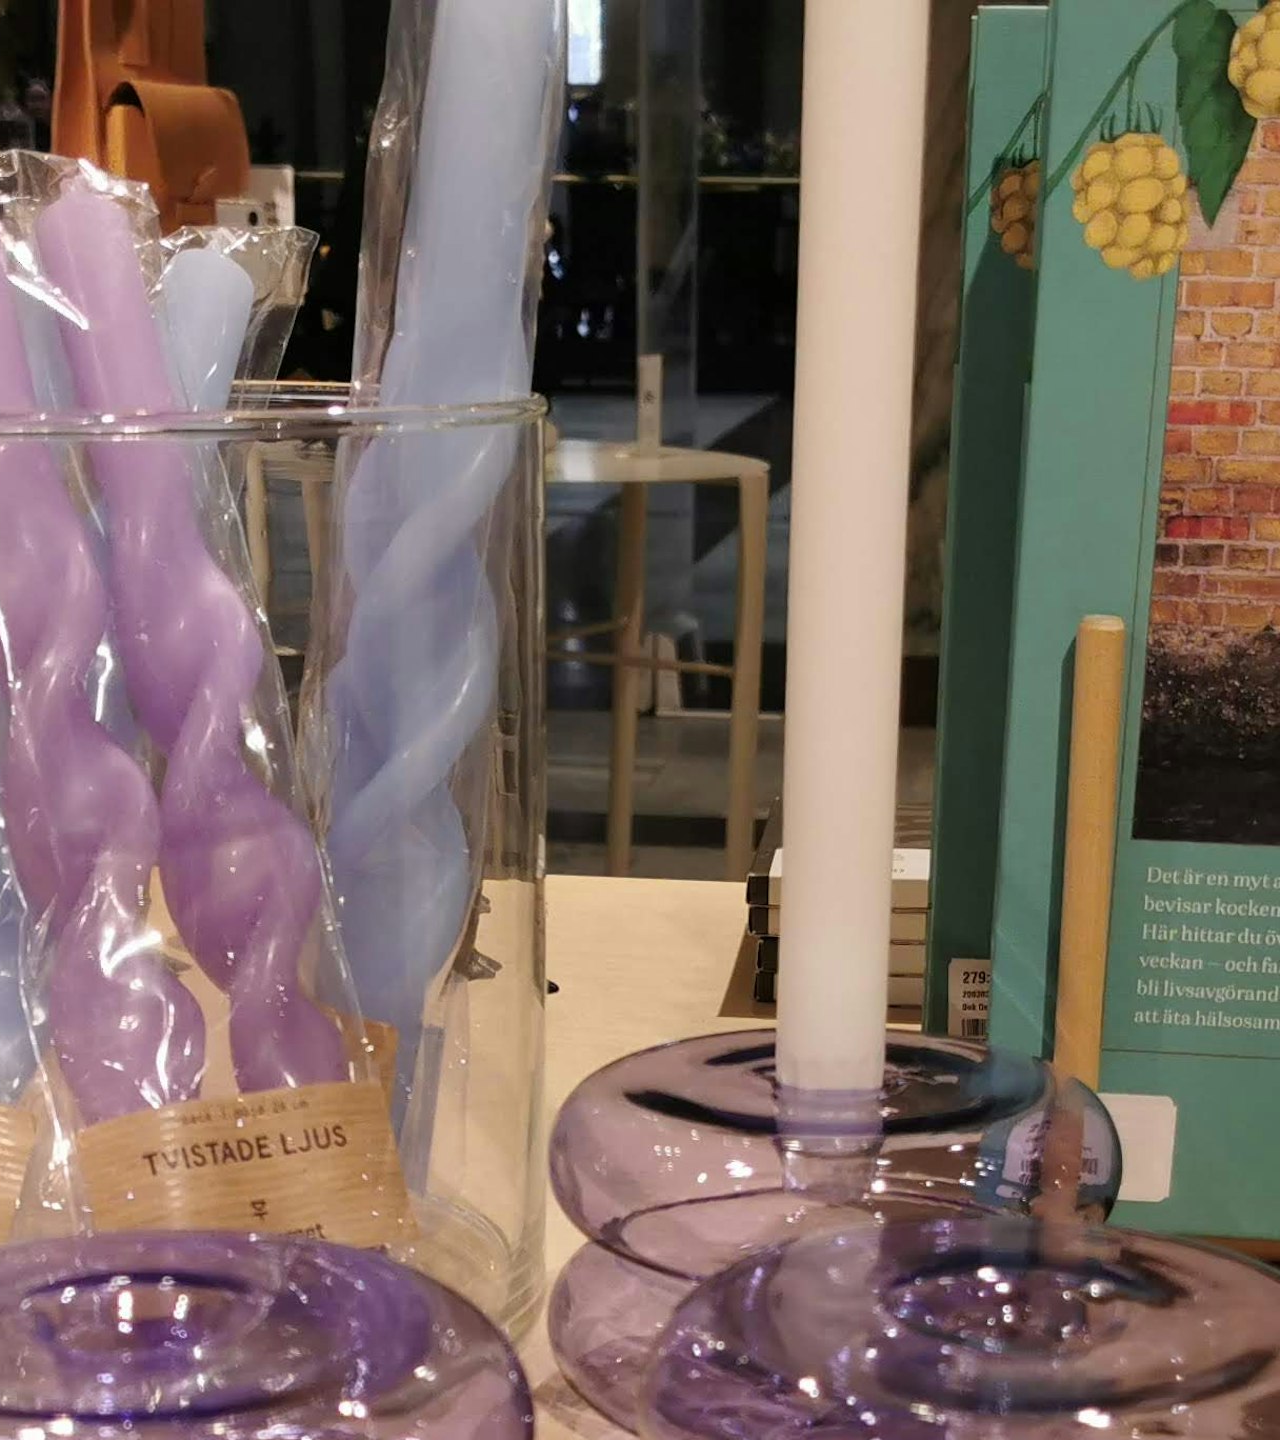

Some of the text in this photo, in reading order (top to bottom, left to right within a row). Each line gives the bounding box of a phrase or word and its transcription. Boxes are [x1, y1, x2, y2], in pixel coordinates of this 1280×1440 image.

[1147, 866, 1180, 884] Det
[1183, 867, 1205, 885] är
[1207, 873, 1228, 886] en
[1233, 873, 1273, 891] myt
[1144, 895, 1212, 915] bevisar
[1215, 898, 1280, 918] kocken
[1142, 923, 1177, 941] Här
[1181, 925, 1236, 943] hittar
[1238, 928, 1261, 944] du
[1139, 952, 1203, 970] veckan
[1225, 956, 1258, 973] och
[1137, 979, 1159, 996] bli
[1134, 1009, 1160, 1024] att
[1163, 1009, 1191, 1025] äta
[142, 1124, 348, 1176] TVISTADE LJUS
